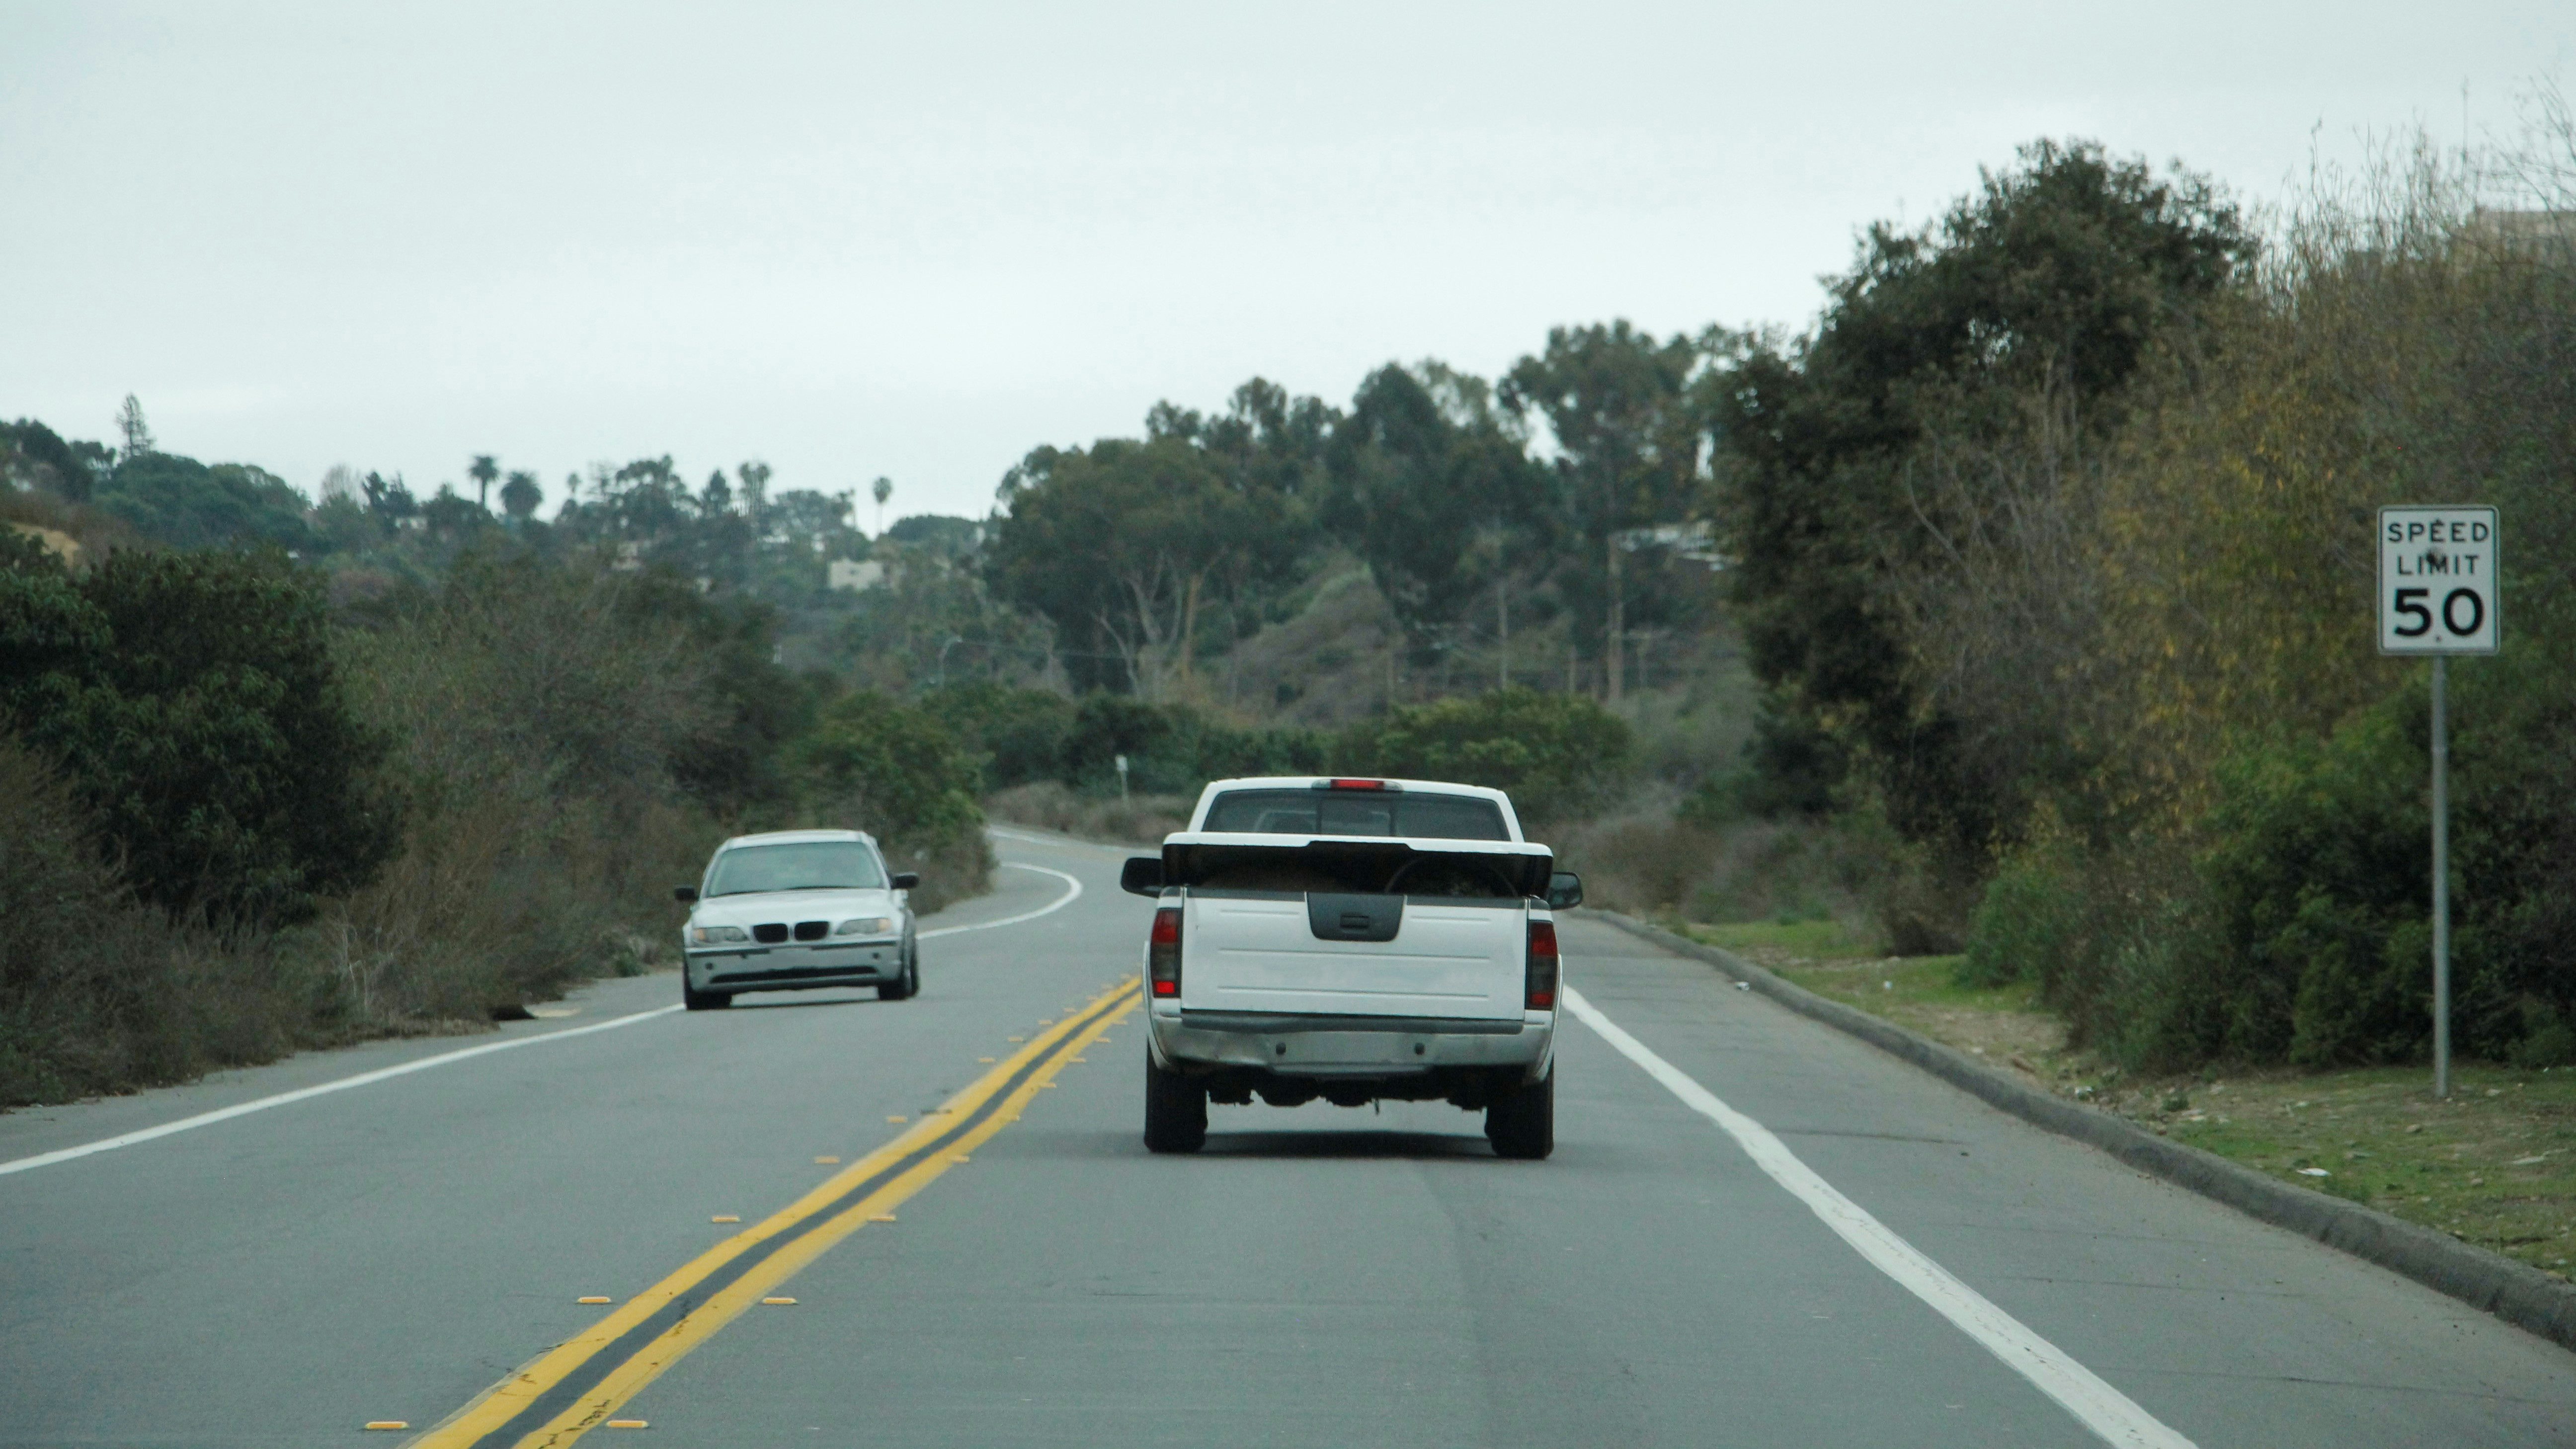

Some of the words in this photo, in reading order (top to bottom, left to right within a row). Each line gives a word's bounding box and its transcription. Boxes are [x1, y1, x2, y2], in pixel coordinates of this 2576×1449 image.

[2388, 523, 2489, 542] SPEED
[2397, 555, 2479, 574] LIMIT
[2394, 588, 2484, 637] 50
